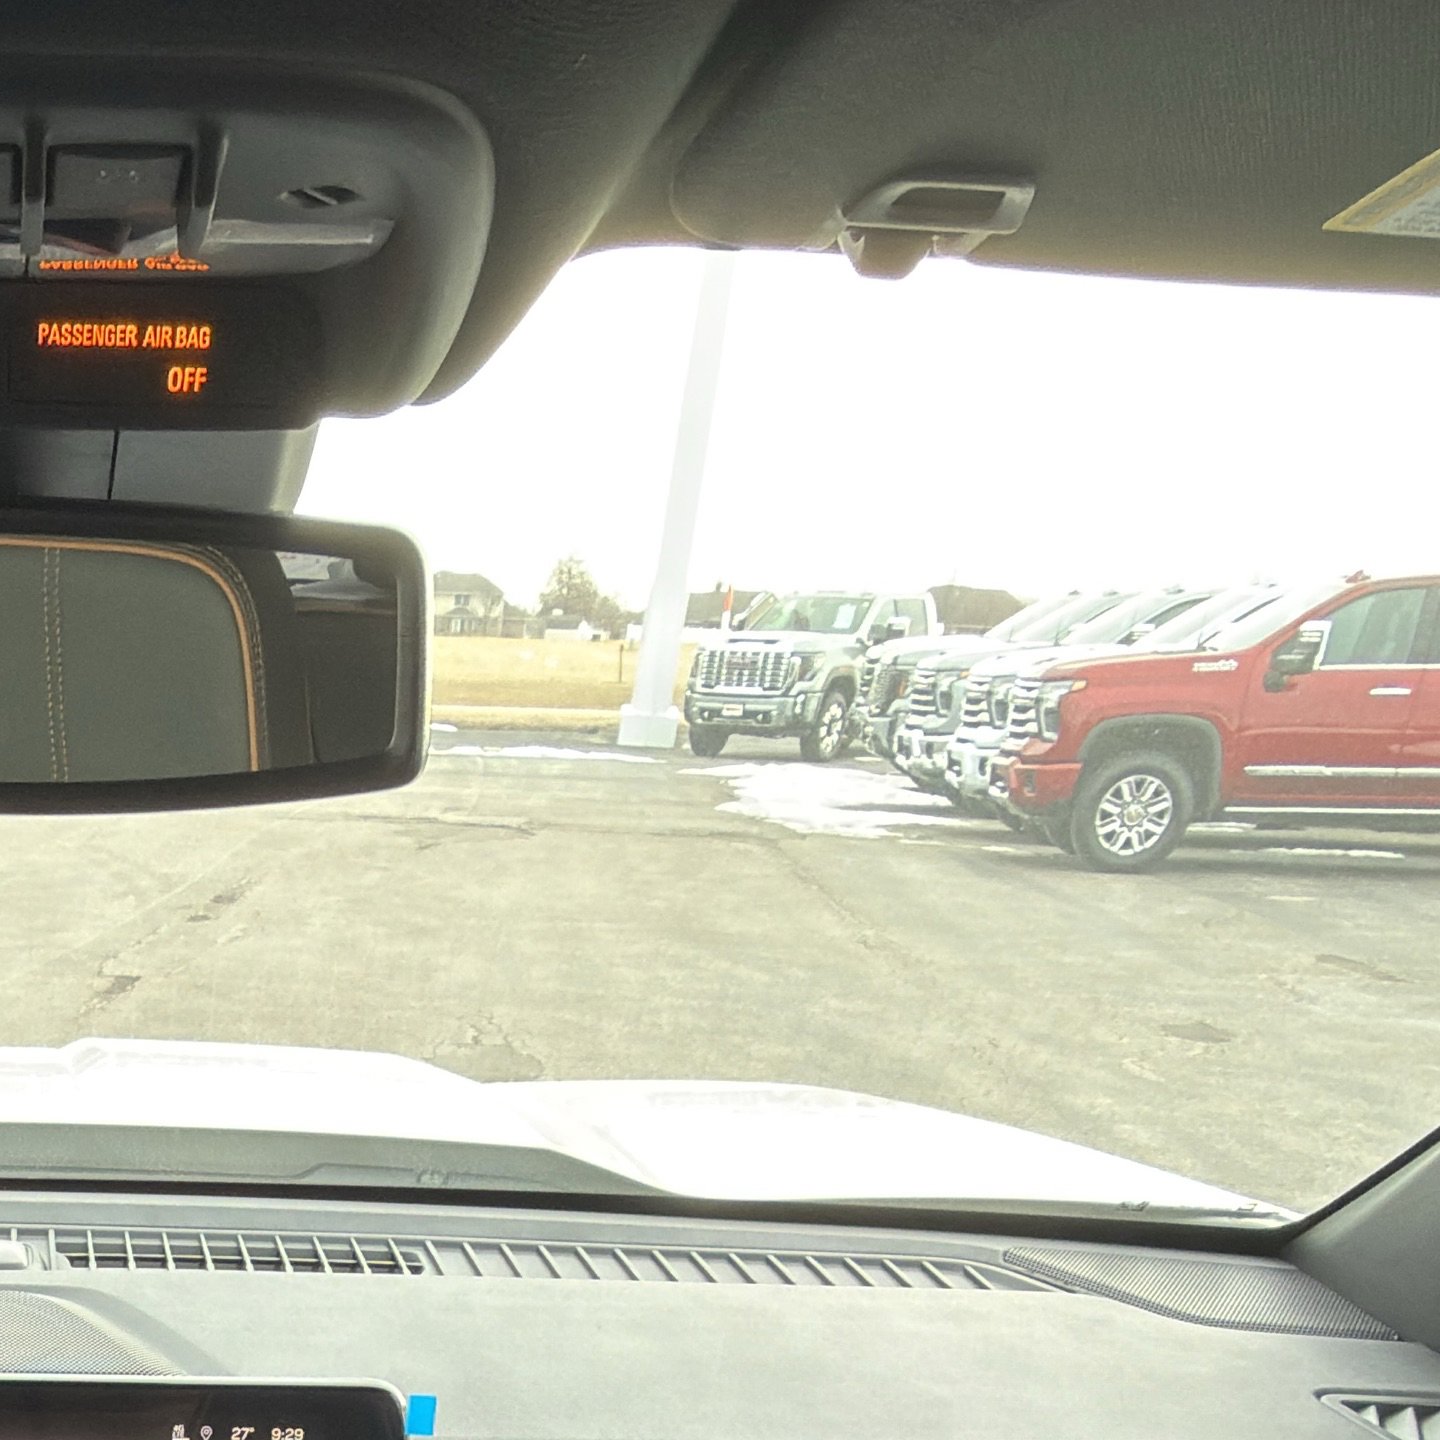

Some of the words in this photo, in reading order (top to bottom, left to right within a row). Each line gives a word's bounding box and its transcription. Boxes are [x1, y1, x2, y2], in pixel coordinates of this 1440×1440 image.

[37, 322, 138, 349] PASSENGER
[142, 324, 172, 349] AIR
[174, 325, 211, 350] BAG
[166, 366, 209, 394] OFF
